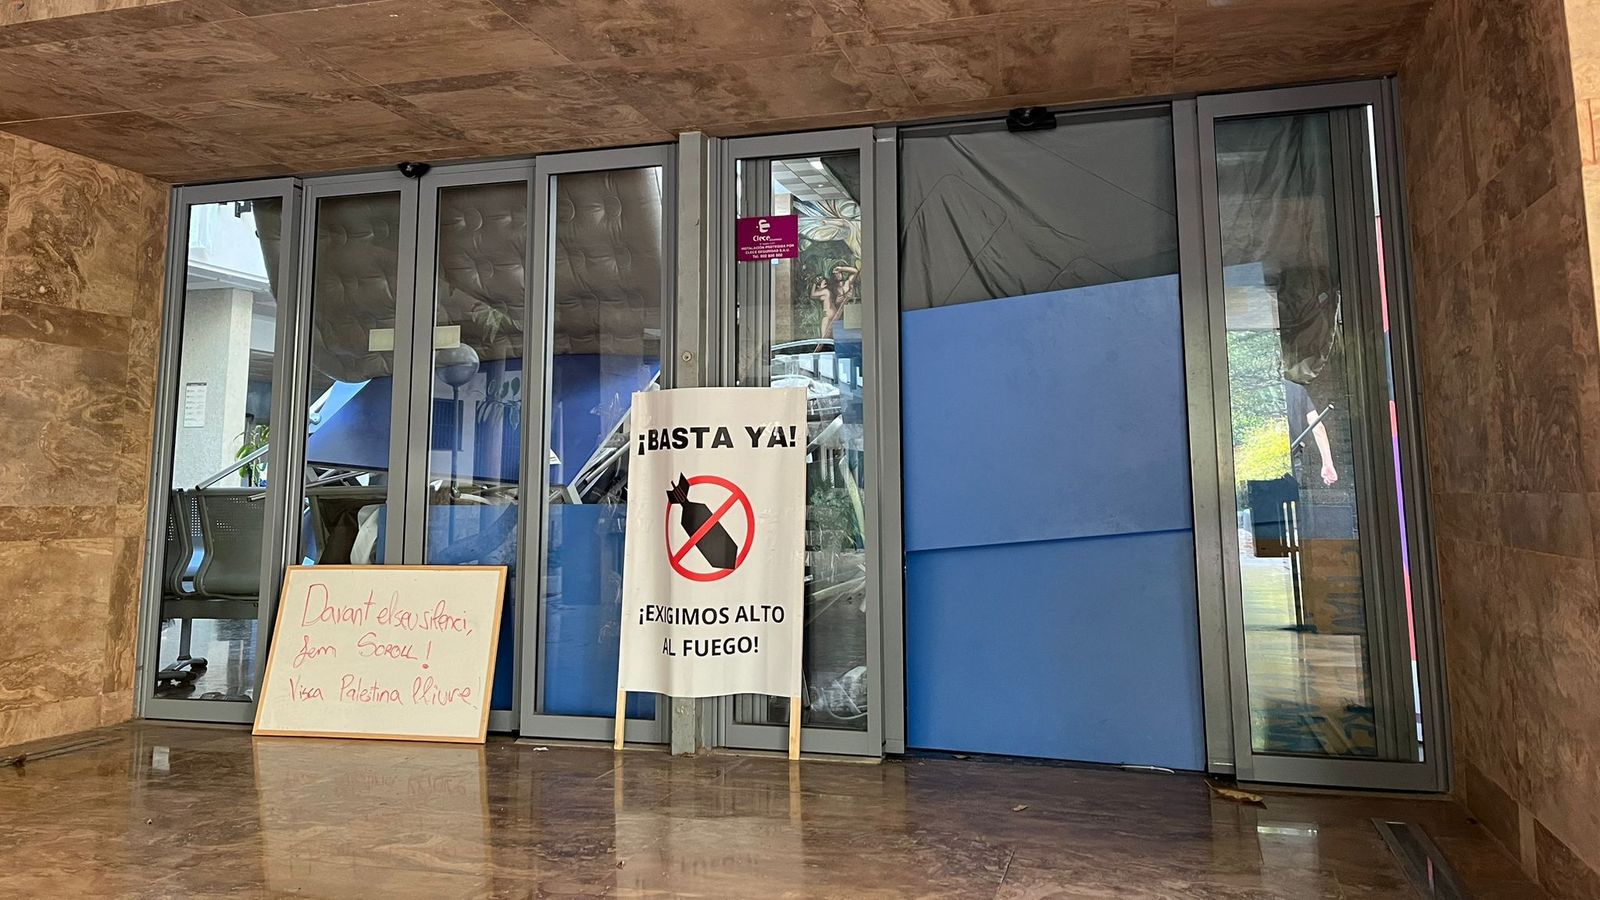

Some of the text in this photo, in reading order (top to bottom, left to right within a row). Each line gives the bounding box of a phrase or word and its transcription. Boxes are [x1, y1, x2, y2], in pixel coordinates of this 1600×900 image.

[637, 425, 797, 456] ¡BASTA YA!
[302, 583, 376, 627] Davant
[639, 604, 785, 626] ¡EXIGIMOS ALTO
[662, 635, 759, 657] AL FUEGO!
[339, 674, 404, 704] Palestina
